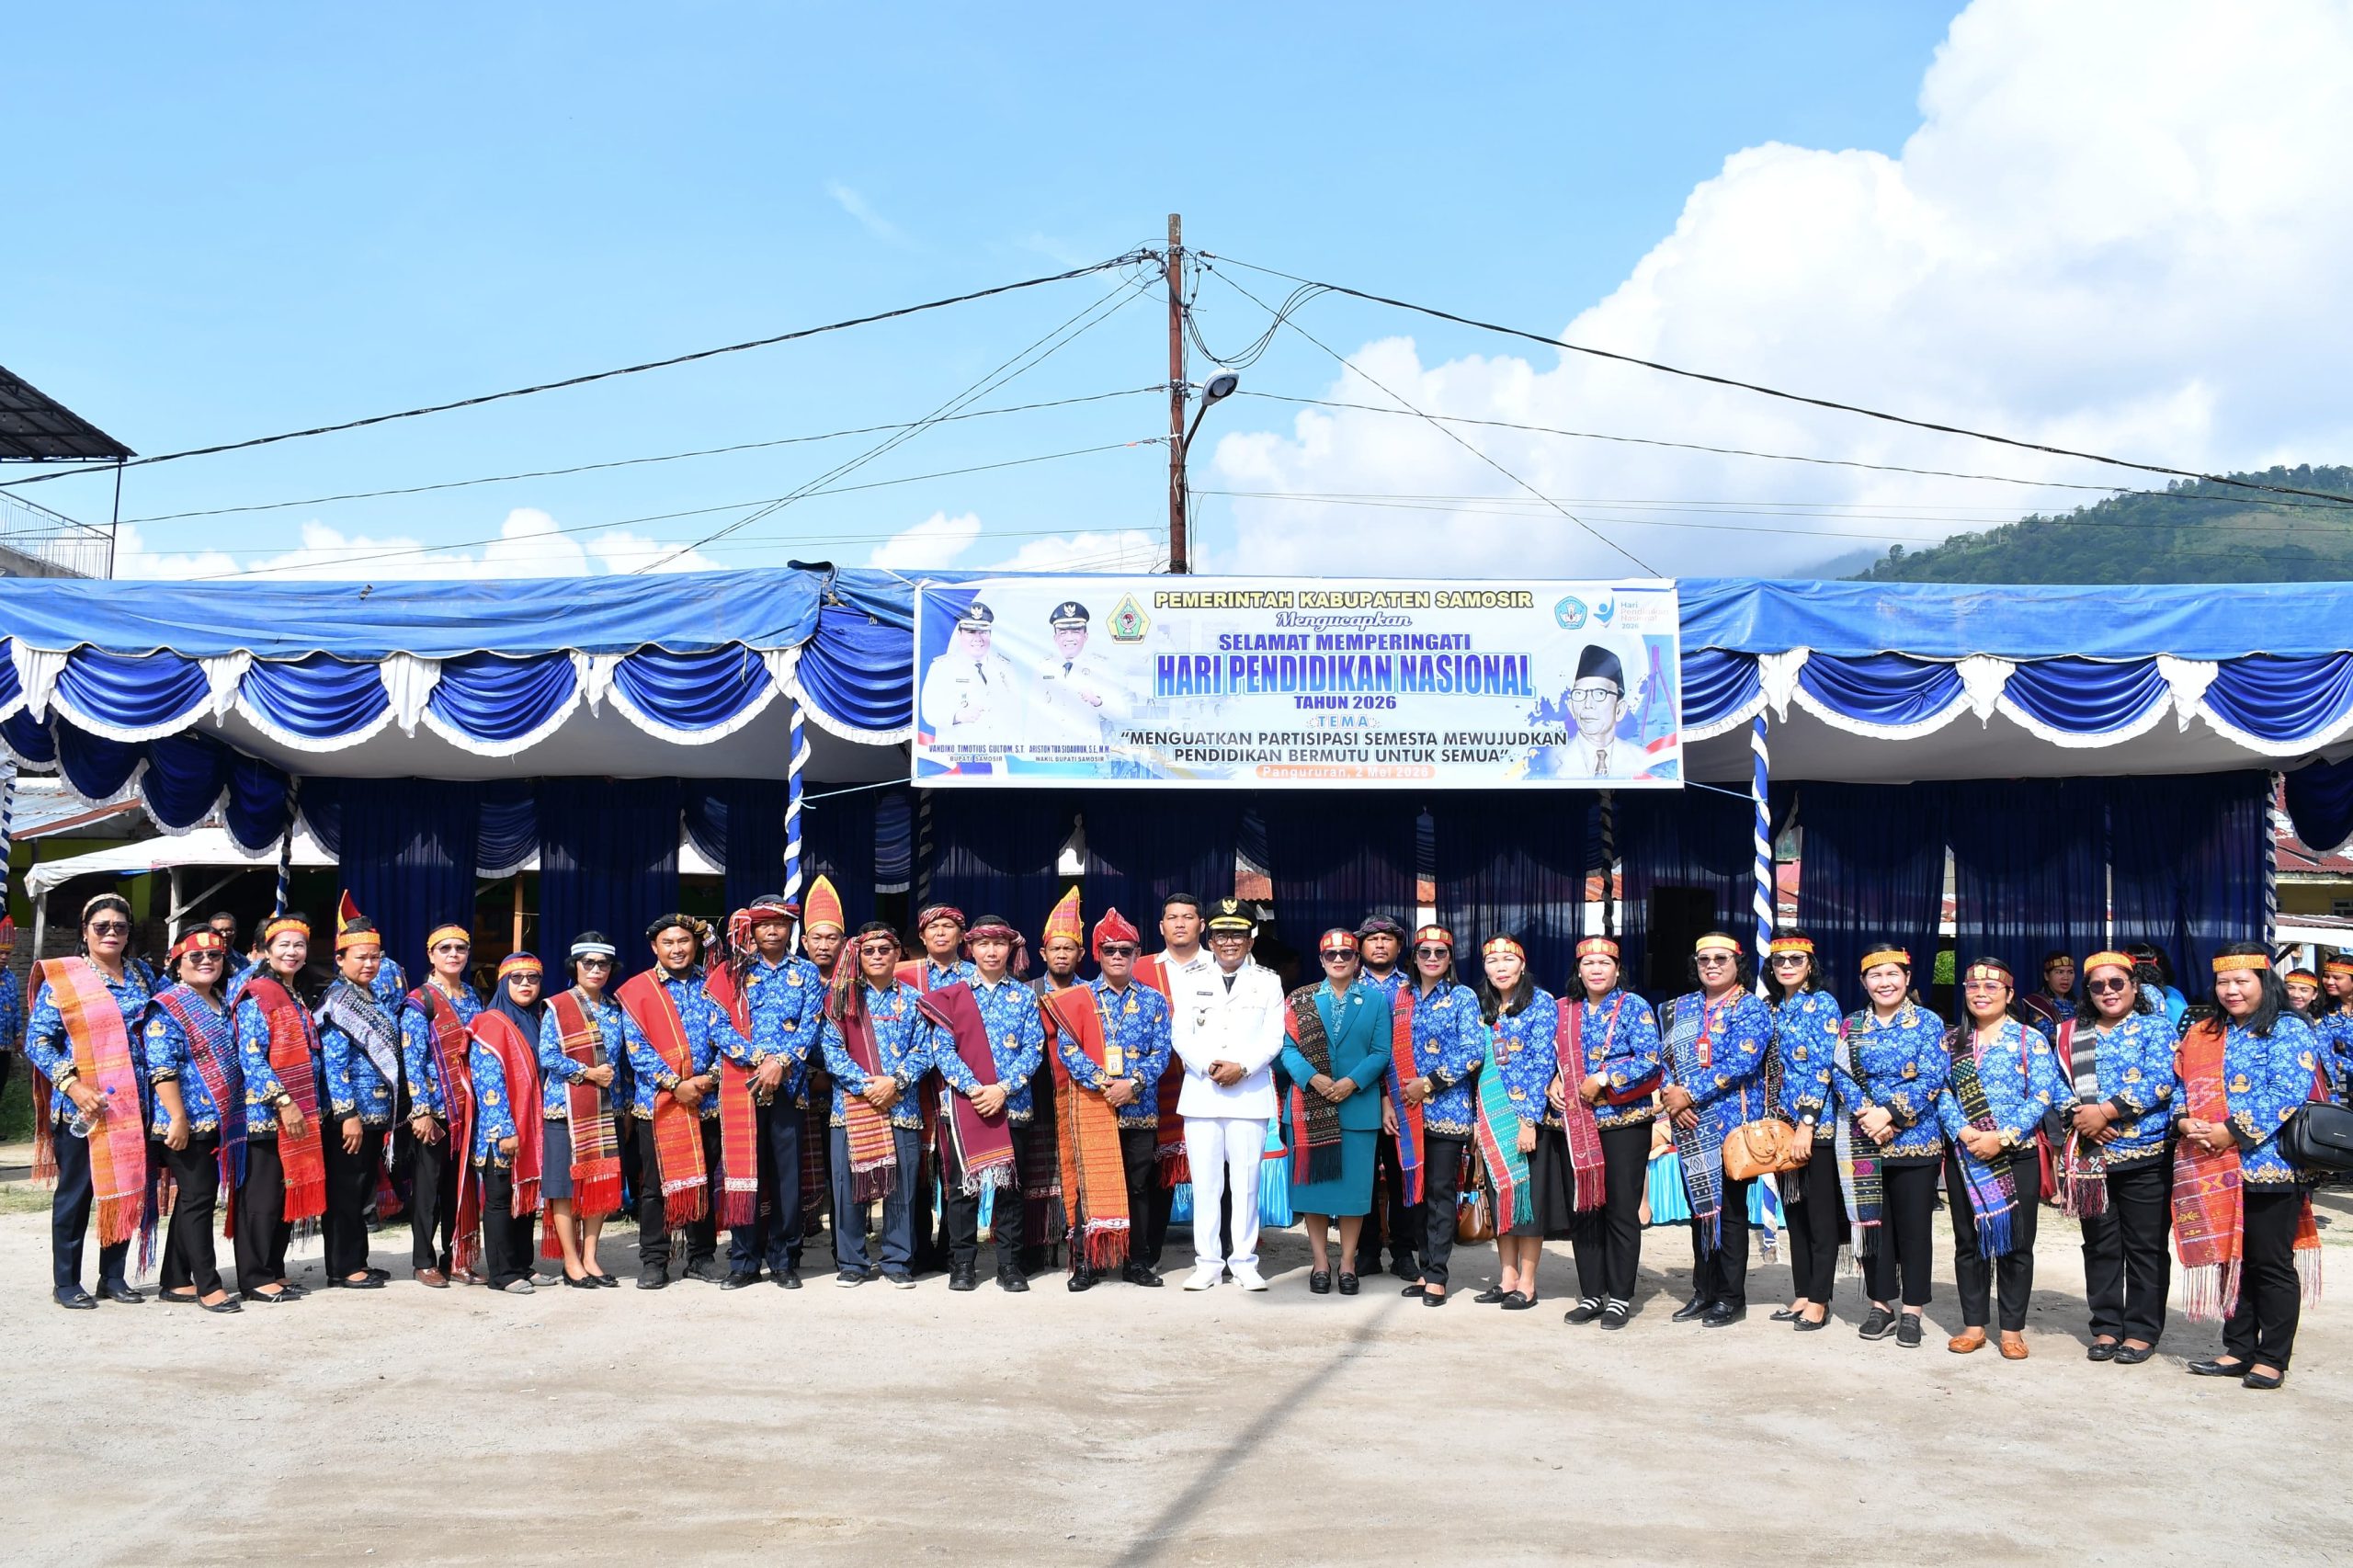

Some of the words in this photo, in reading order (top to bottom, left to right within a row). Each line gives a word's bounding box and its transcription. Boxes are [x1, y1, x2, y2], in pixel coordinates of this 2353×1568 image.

[1154, 591, 1293, 608] PEMERINTAH
[1299, 591, 1430, 608] KABUPATEN
[1435, 591, 1534, 608] SAMOSIR
[1276, 611, 1413, 631] Mengucapkan
[1219, 633, 1310, 651] SELAMAT
[1315, 633, 1471, 651] MEMPERINGATI
[1156, 653, 1222, 697] HARI
[1228, 653, 1393, 694] PENDIDIKAN
[1398, 653, 1535, 697] NASIONAL
[1294, 696, 1348, 709] TAHUN
[1353, 696, 1396, 709] 2026
[1318, 715, 1369, 728] TEMA
[1120, 732, 1252, 745] “MENGUATKAN
[1258, 732, 1358, 745] PARTISIPASI
[1364, 732, 1438, 745] SEMESTA
[1443, 732, 1567, 745] MEWUJUDKAN
[928, 744, 955, 753] VANDIKO
[958, 744, 986, 753] TIMOTIUS
[1029, 744, 1051, 754] ARISTON
[1175, 748, 1282, 762] PENDIDIKAN
[1290, 748, 1369, 762] BERMUTU
[1375, 748, 1436, 762] UNTUK
[1263, 767, 1350, 779] Pangururan,
[1356, 767, 1364, 778] 2
[1368, 767, 1392, 778] Mei
